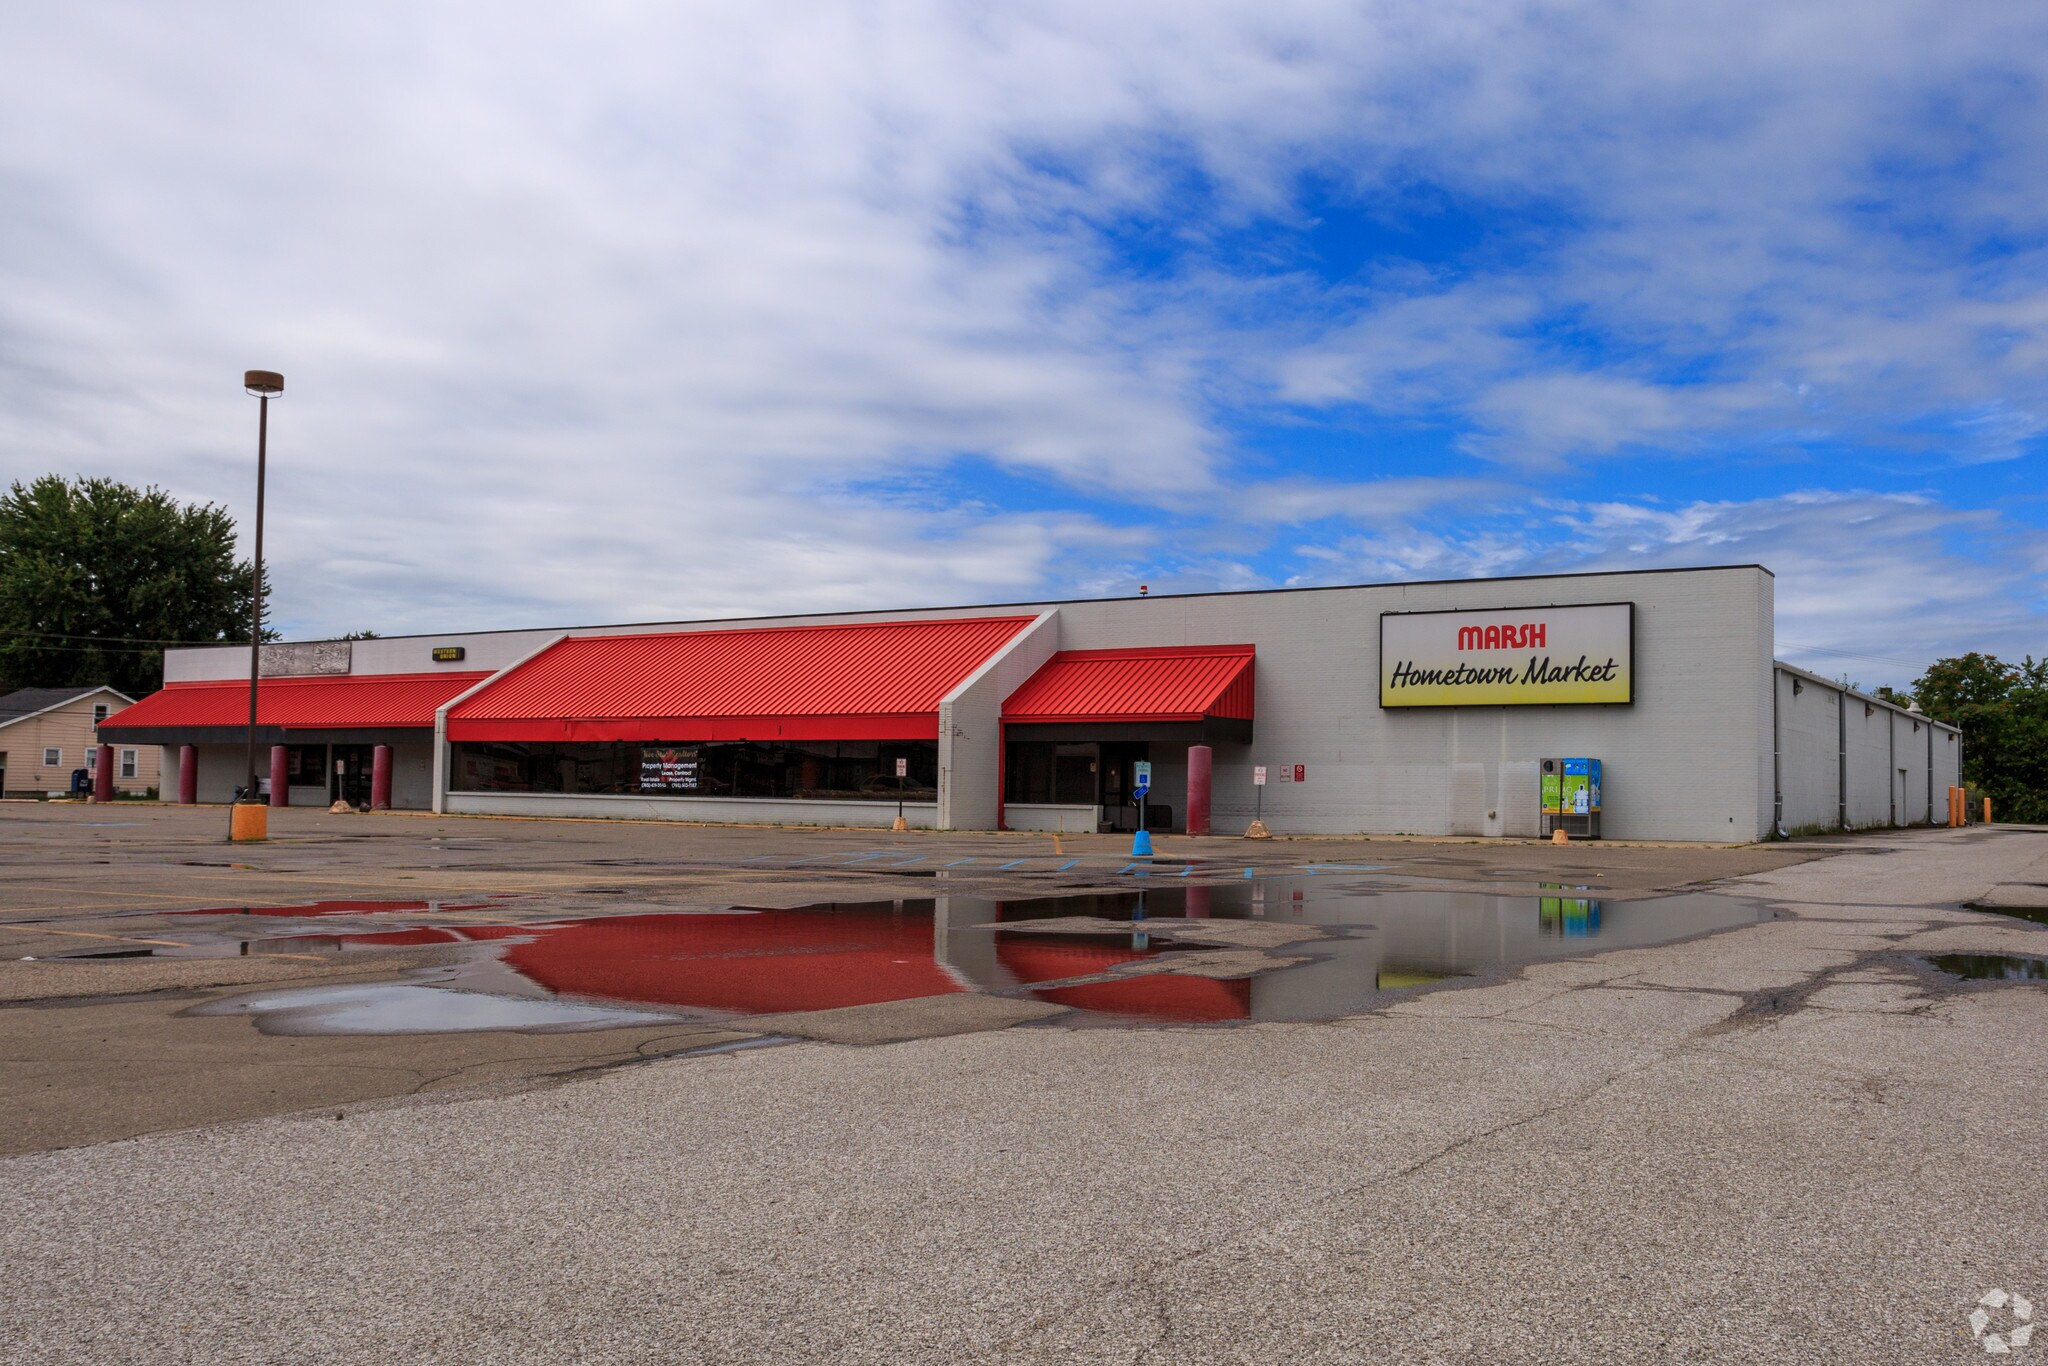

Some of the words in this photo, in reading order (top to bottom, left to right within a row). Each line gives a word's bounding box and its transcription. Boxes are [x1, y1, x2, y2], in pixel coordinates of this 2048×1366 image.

[1458, 623, 1546, 650] MARSH
[1390, 660, 1519, 689] Hometown
[1520, 655, 1620, 686] Market
